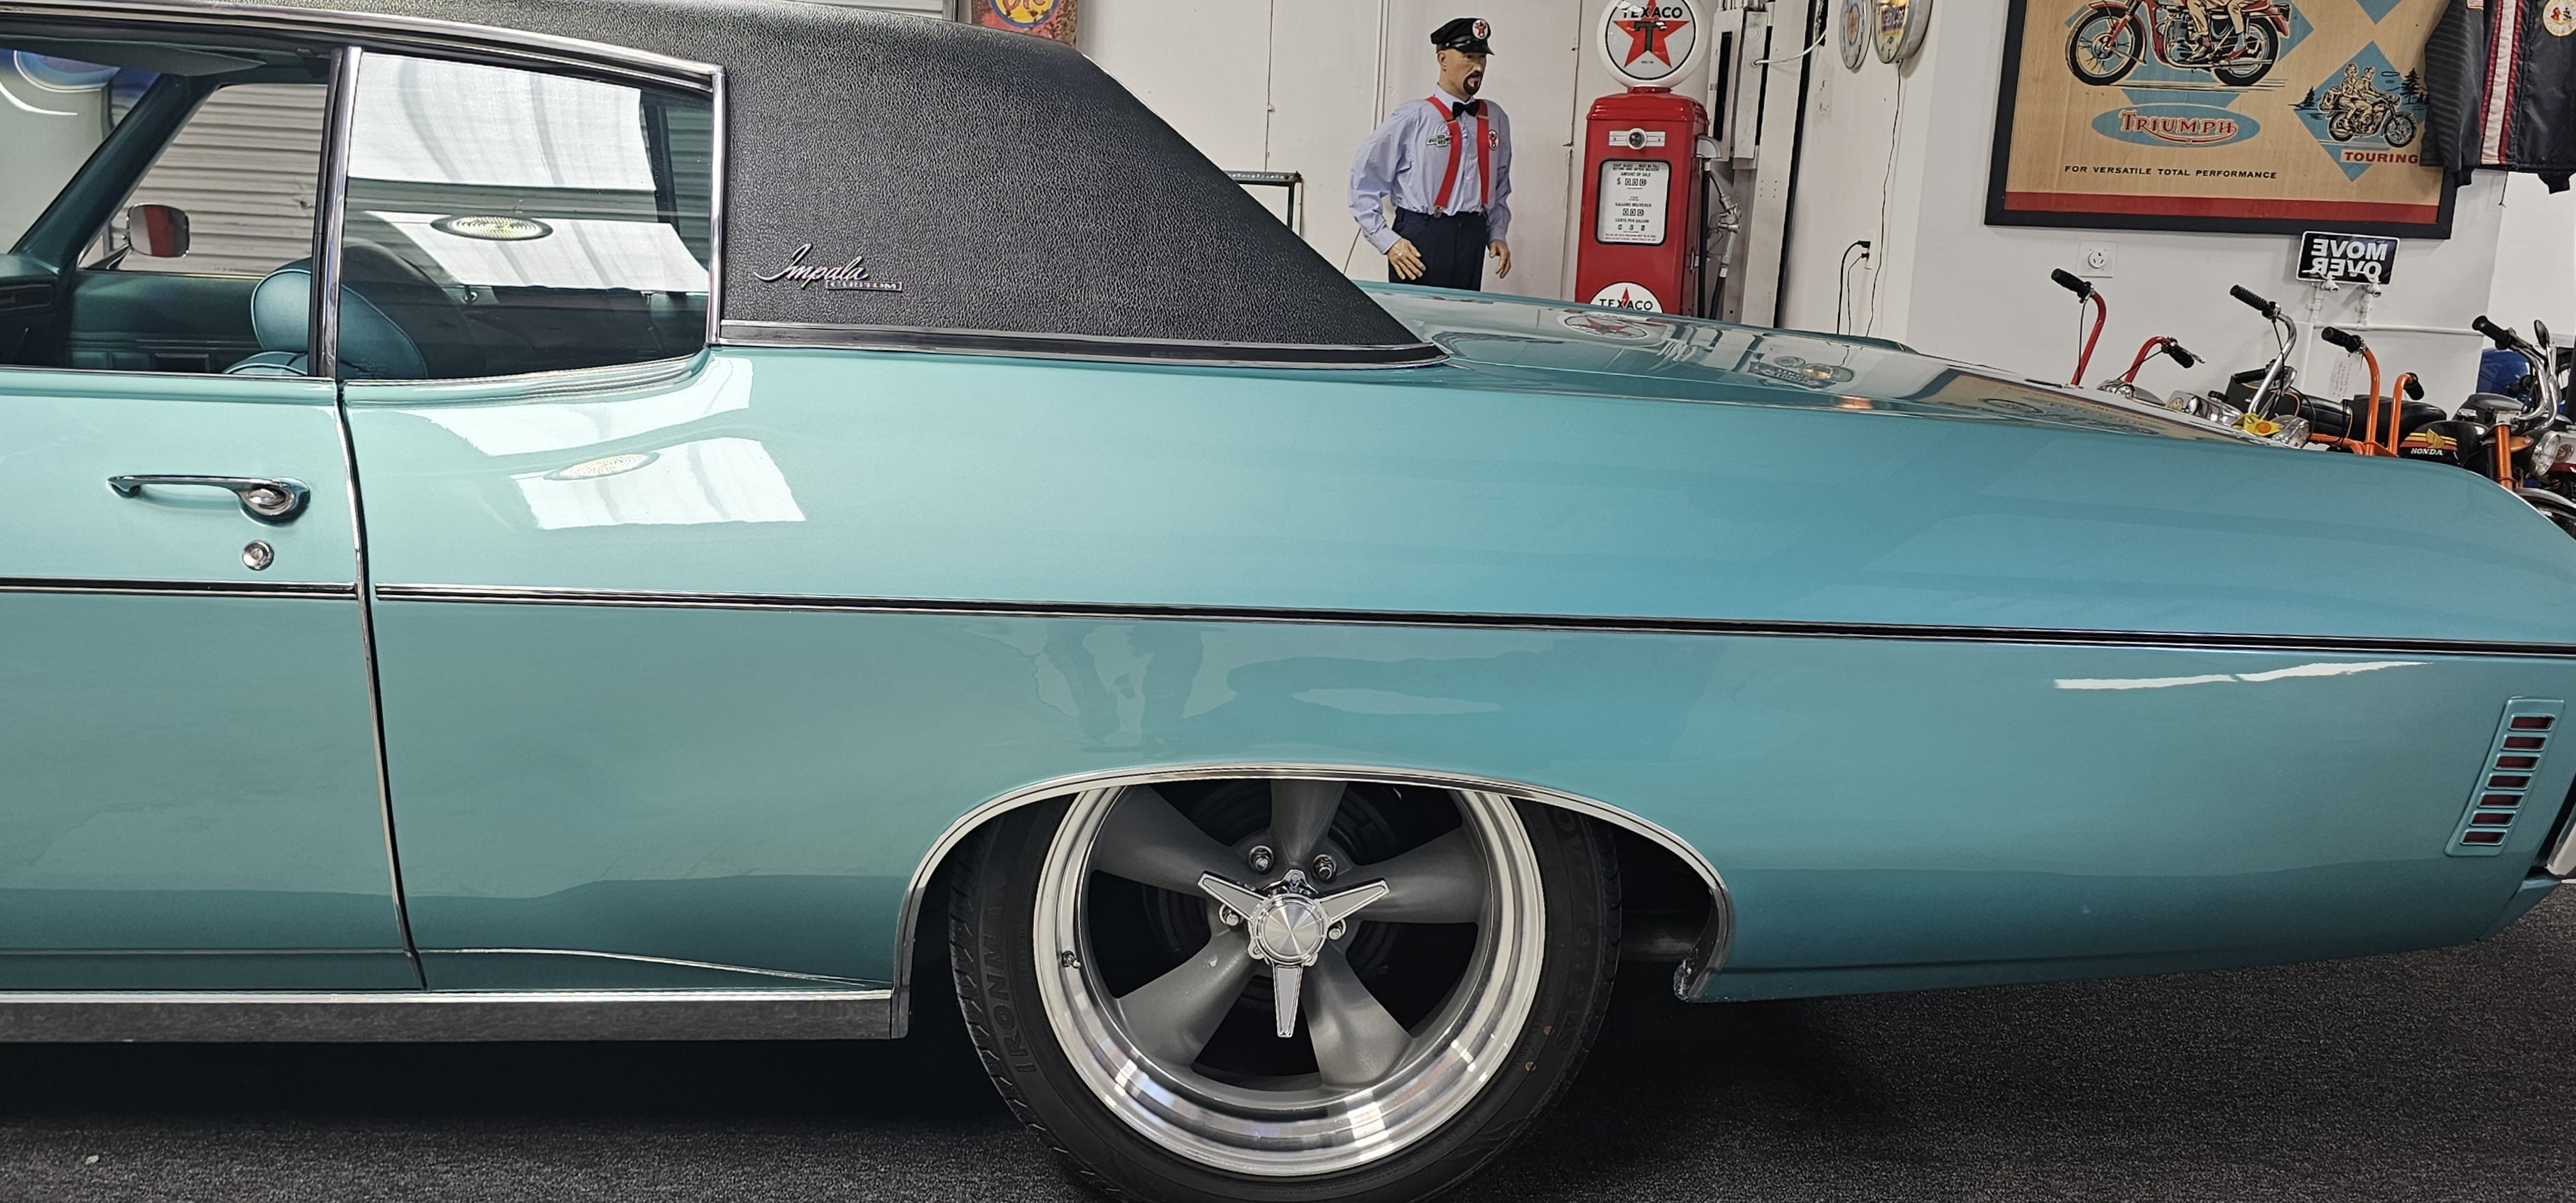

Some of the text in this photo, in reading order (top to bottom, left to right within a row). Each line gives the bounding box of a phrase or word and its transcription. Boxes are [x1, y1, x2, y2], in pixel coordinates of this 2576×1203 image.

[1621, 6, 1683, 18] TEXACO
[2121, 111, 2238, 142] TRIUMPH
[2344, 152, 2418, 164] TOURING
[2093, 166, 2152, 175] VERSATILE
[2195, 170, 2277, 179] PERFORMANCE
[754, 243, 869, 290] Impala
[830, 281, 898, 290] CUSTOM
[1599, 298, 1653, 311] TEXACO
[2410, 447, 2444, 456] HONDA
